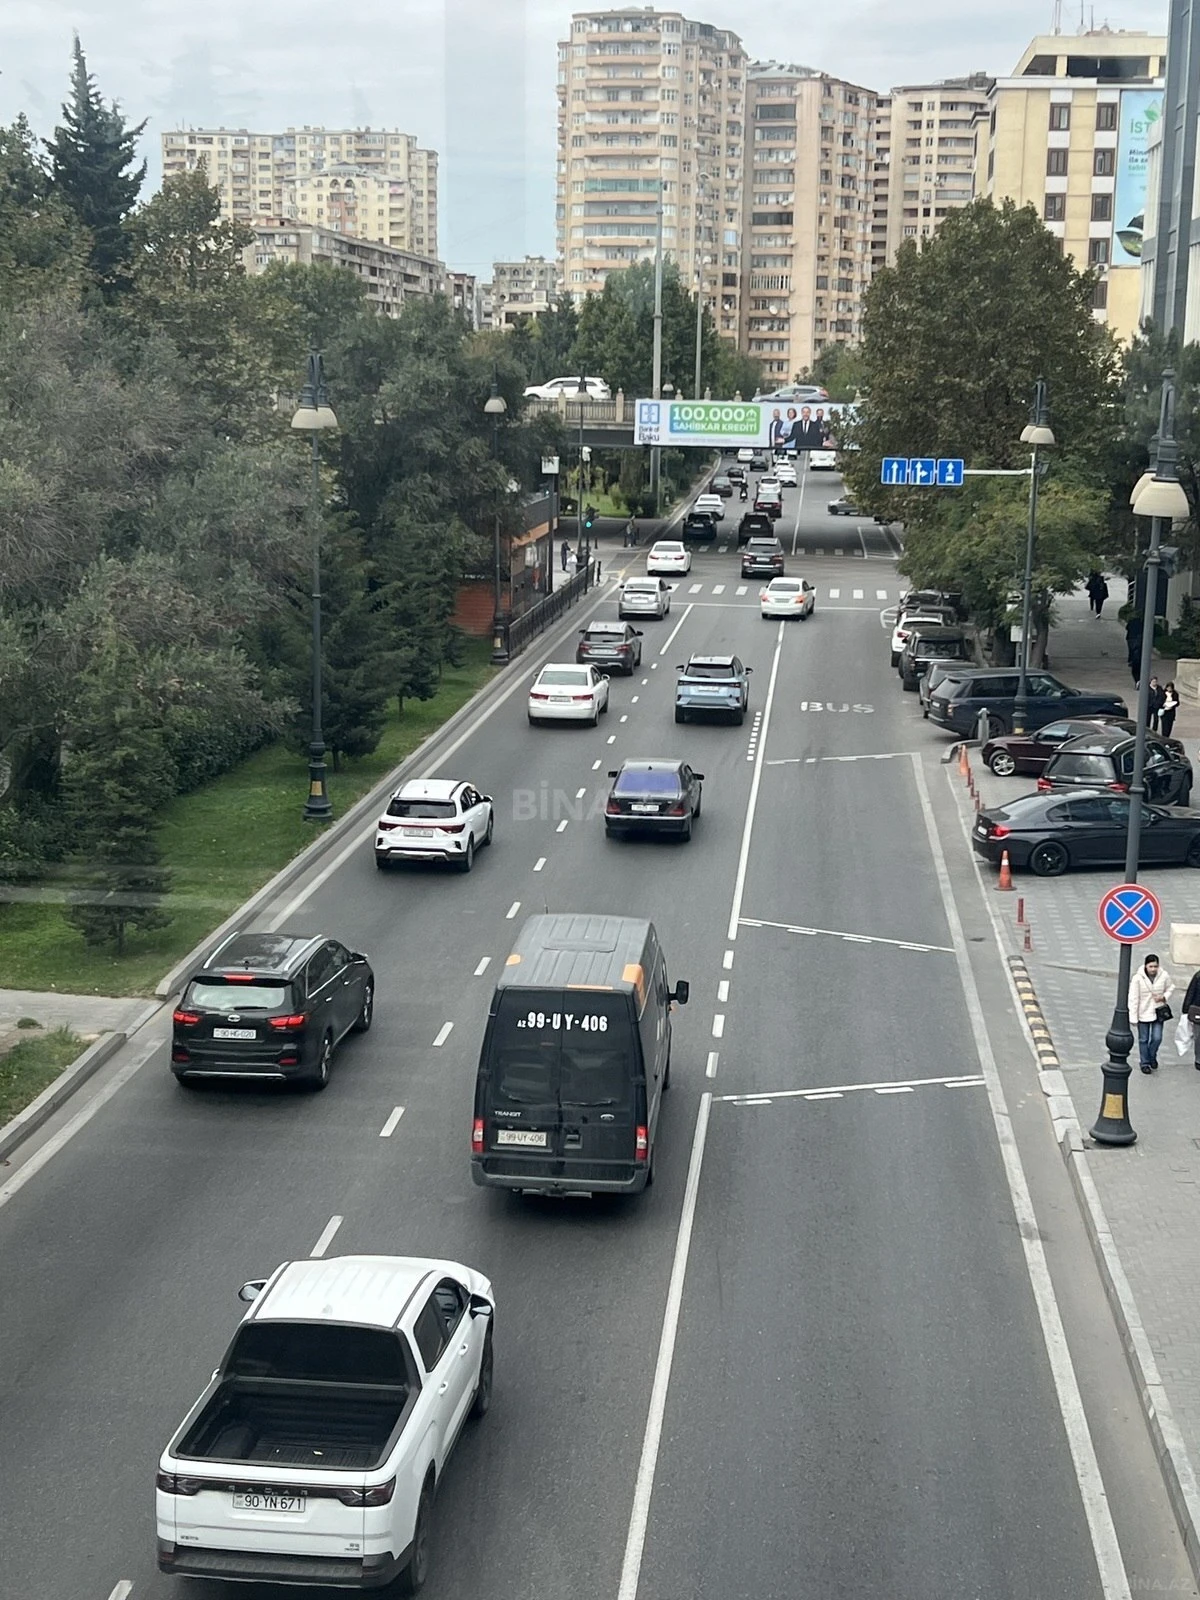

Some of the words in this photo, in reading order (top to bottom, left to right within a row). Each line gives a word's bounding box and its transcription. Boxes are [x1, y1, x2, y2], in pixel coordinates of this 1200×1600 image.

[673, 420, 721, 432] SAHİBKAR
[721, 421, 757, 433] KREDİTİ
[639, 432, 660, 442] Baku
[800, 701, 875, 714] BUS
